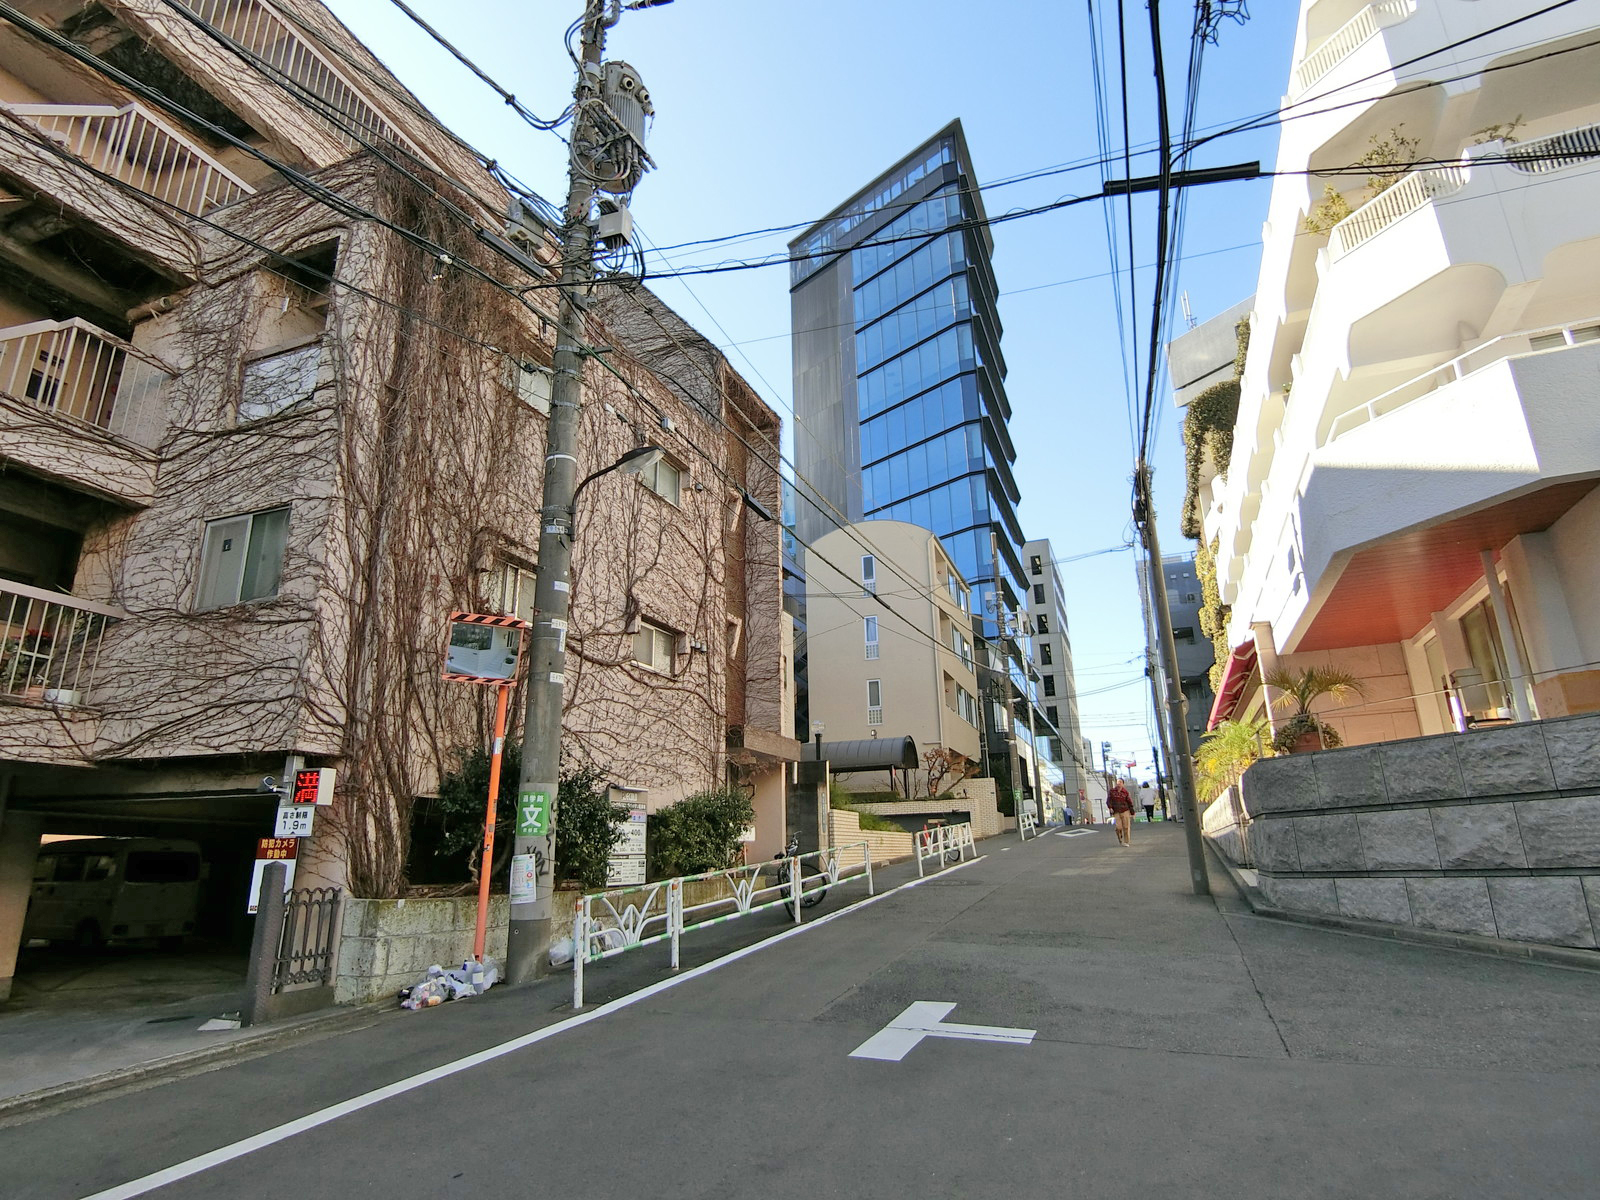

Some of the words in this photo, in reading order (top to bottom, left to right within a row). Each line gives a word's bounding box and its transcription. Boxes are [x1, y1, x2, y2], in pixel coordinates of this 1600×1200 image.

[294, 772, 319, 803] 満
[282, 811, 308, 820] 高さ制限
[521, 804, 542, 828] 文
[282, 820, 306, 830] 1.9m
[261, 838, 295, 848] 防犯カメラ
[266, 850, 287, 858] 作動中
